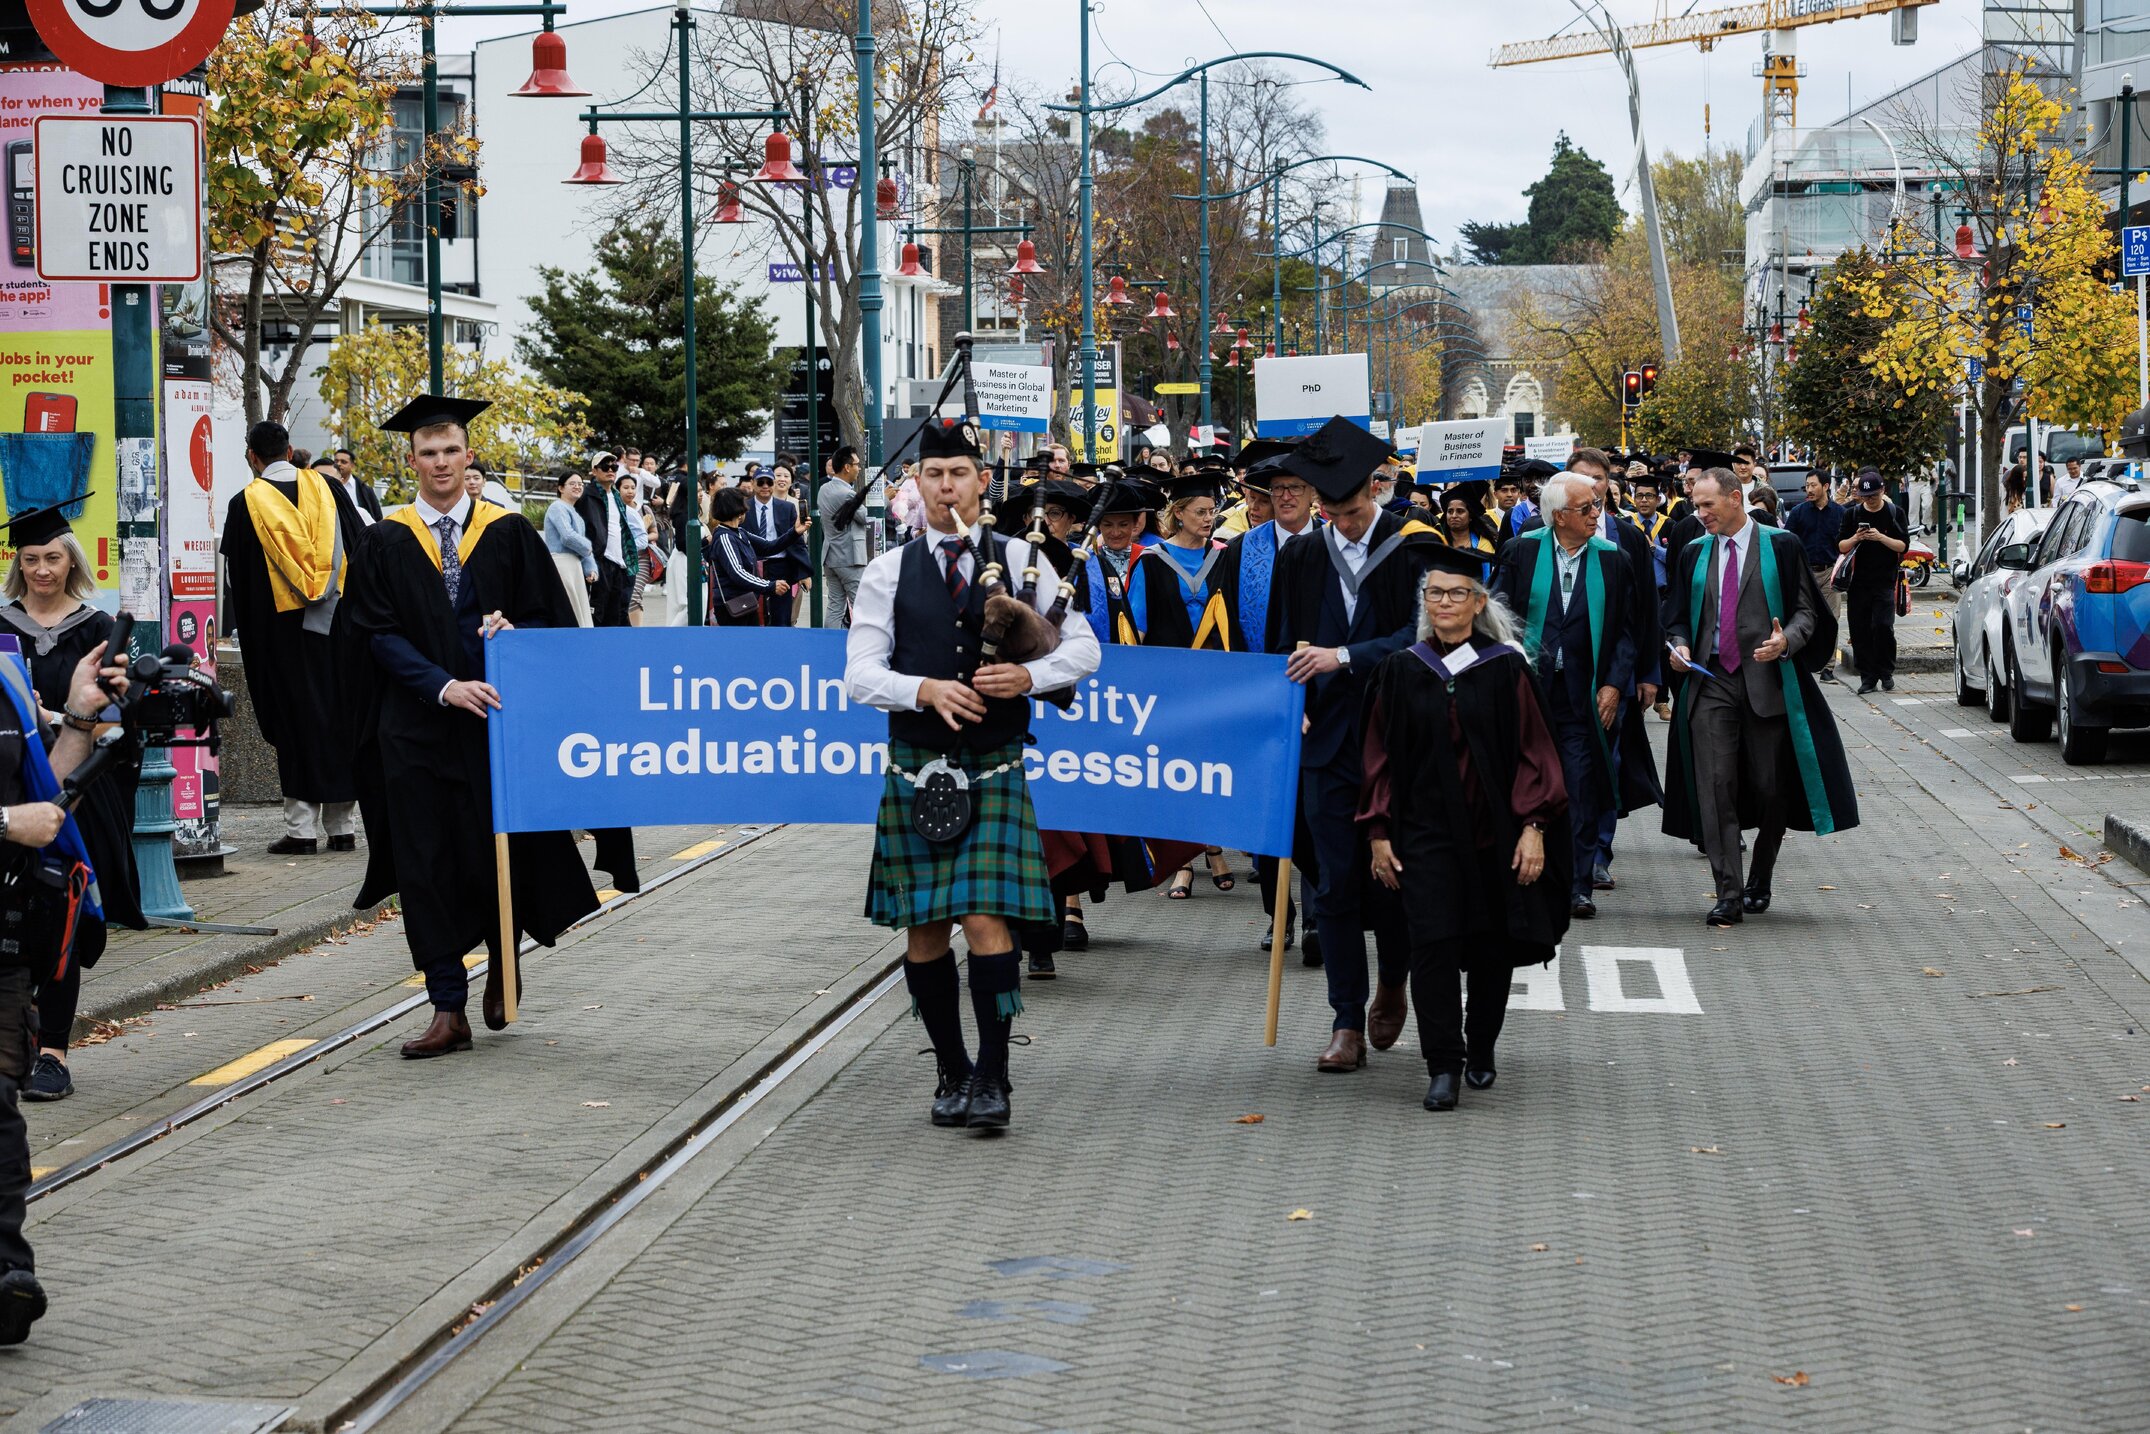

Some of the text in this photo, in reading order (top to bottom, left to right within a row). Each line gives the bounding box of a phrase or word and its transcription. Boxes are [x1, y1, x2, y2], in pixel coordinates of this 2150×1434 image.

[1, 96, 23, 109] for
[27, 95, 72, 108] when
[102, 127, 132, 156] NO
[62, 164, 173, 195] CRUISING
[89, 203, 149, 233] ZONE
[89, 241, 150, 271] ENDS
[2131, 244, 2144, 255] 120
[6, 281, 51, 289] students.
[19, 289, 51, 304] app!
[0, 351, 94, 368] Jobs in your
[13, 370, 73, 386] pocket!
[989, 369, 1028, 379] Master of
[973, 379, 1045, 392] Business in Global
[1302, 384, 1321, 392] PhD
[977, 391, 1030, 402] Management
[987, 402, 1028, 414] Marketing
[1444, 430, 1484, 441] Master of
[1095, 445, 1112, 455] shot
[1444, 442, 1481, 451] Business
[1440, 452, 1482, 461] in Finance
[188, 669, 213, 686] RONIN
[640, 664, 1158, 735] Lincoln rsity
[557, 728, 1233, 797] Graduation cession
